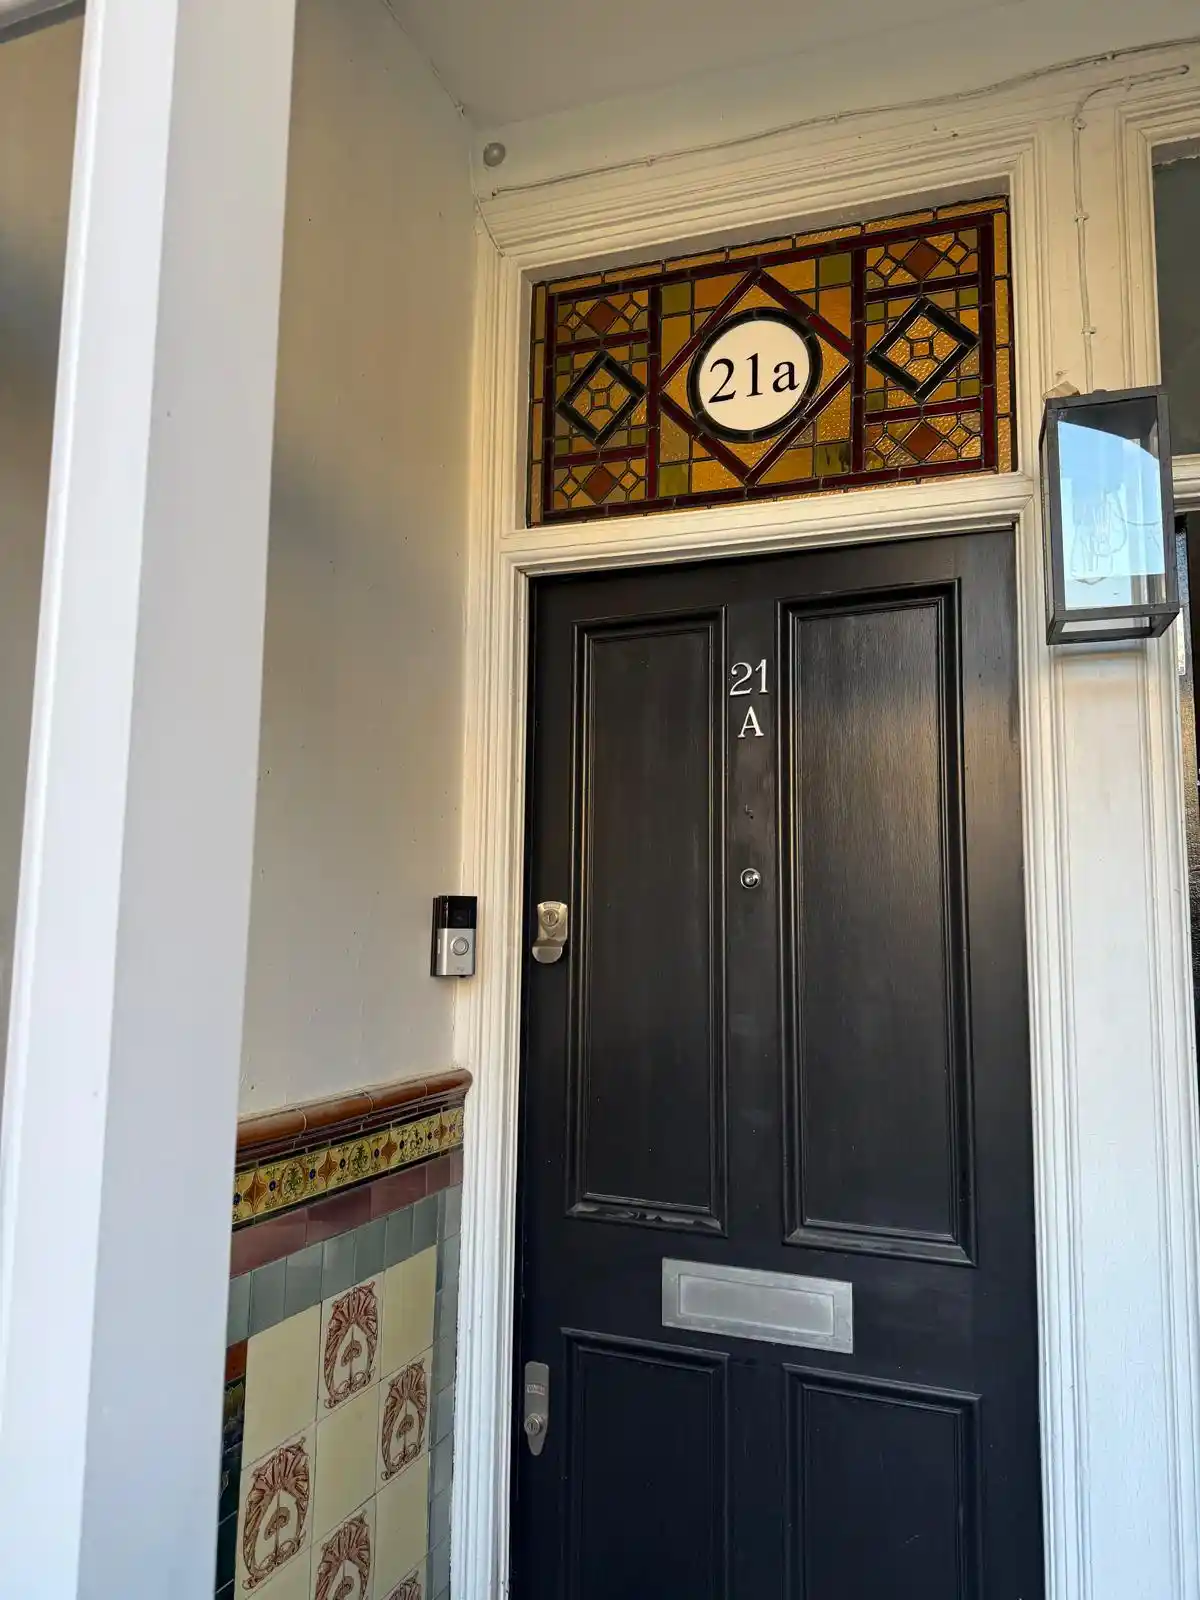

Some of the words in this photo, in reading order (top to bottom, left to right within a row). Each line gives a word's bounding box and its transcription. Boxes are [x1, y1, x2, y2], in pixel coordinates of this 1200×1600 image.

[708, 352, 800, 403] 21a
[729, 659, 768, 696] 21
[737, 705, 764, 738] A
